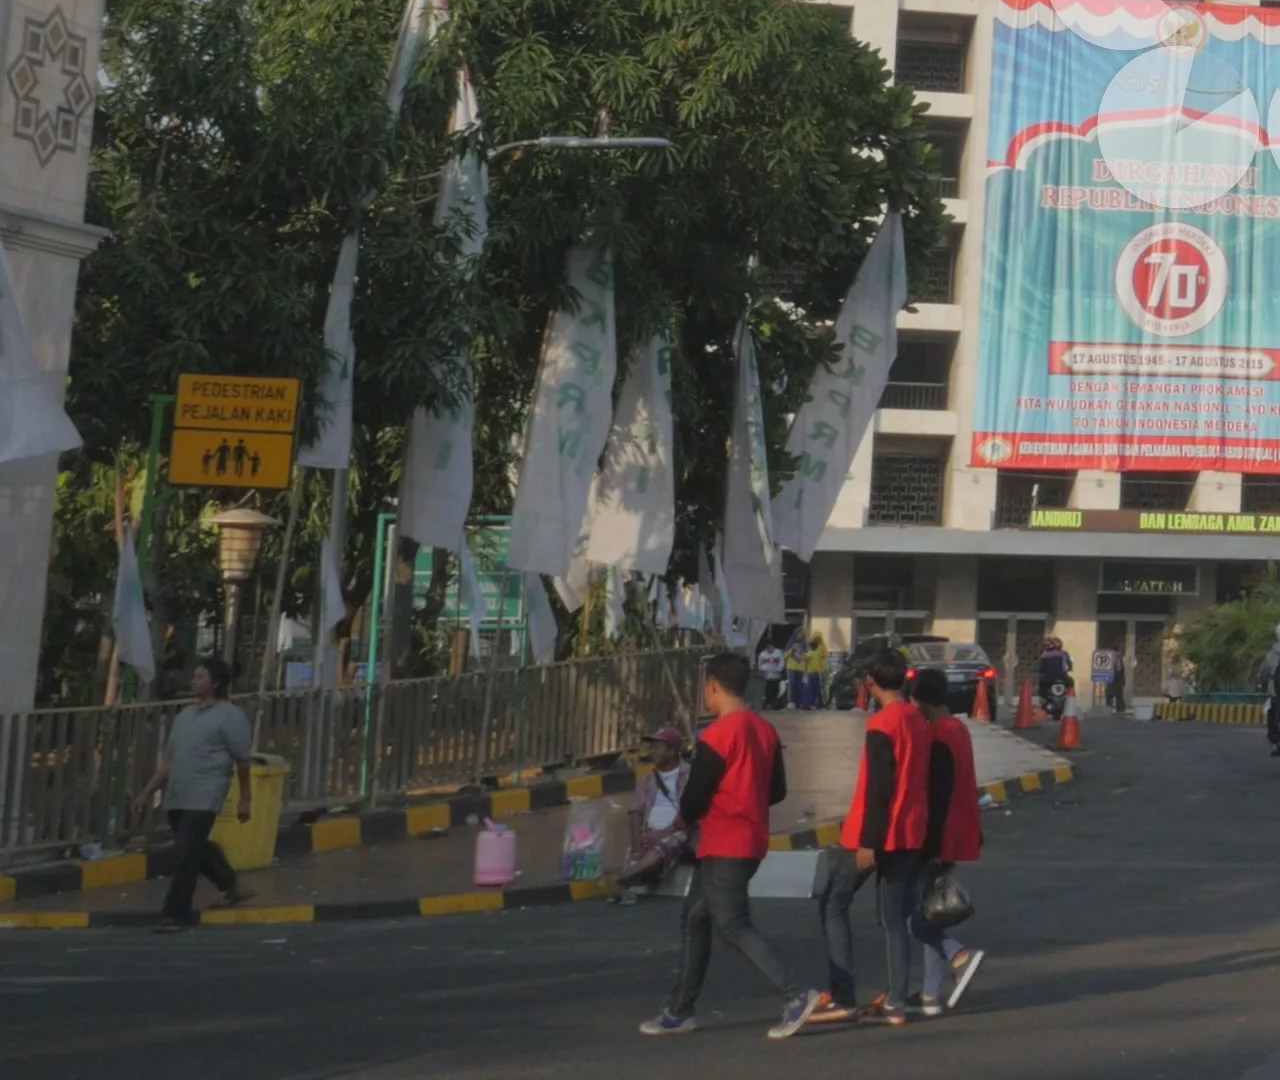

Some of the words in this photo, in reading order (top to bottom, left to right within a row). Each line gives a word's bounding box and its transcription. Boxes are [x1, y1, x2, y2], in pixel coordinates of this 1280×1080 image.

[1093, 160, 1257, 189] DIRGAHAYU
[1042, 184, 1162, 211] REPUBLIK
[1144, 252, 1200, 308] 70
[1072, 353, 1086, 364] 17
[1088, 354, 1137, 365] AGUSTUS
[1175, 356, 1188, 367] 17
[1190, 356, 1236, 368] AGUSTUS
[192, 381, 286, 400] PEDESTRIAN
[1070, 382, 1119, 394] DENGAN
[1123, 383, 1187, 395] SEMANGAT
[1190, 384, 1264, 397] PROKLAMASI
[182, 404, 250, 421] PEJALAN
[254, 408, 292, 423] KAKI
[1017, 398, 1042, 410] KITA
[1046, 399, 1112, 411] WUJUDKAN
[1116, 400, 1171, 413] GERAKAN
[1073, 416, 1089, 428] 70
[1091, 417, 1131, 429] TAHUN
[1134, 419, 1200, 431] INDONESIA
[1139, 512, 1165, 530] DAN
[1167, 513, 1225, 531] LEMBAGA
[1227, 514, 1257, 532] AMIL
